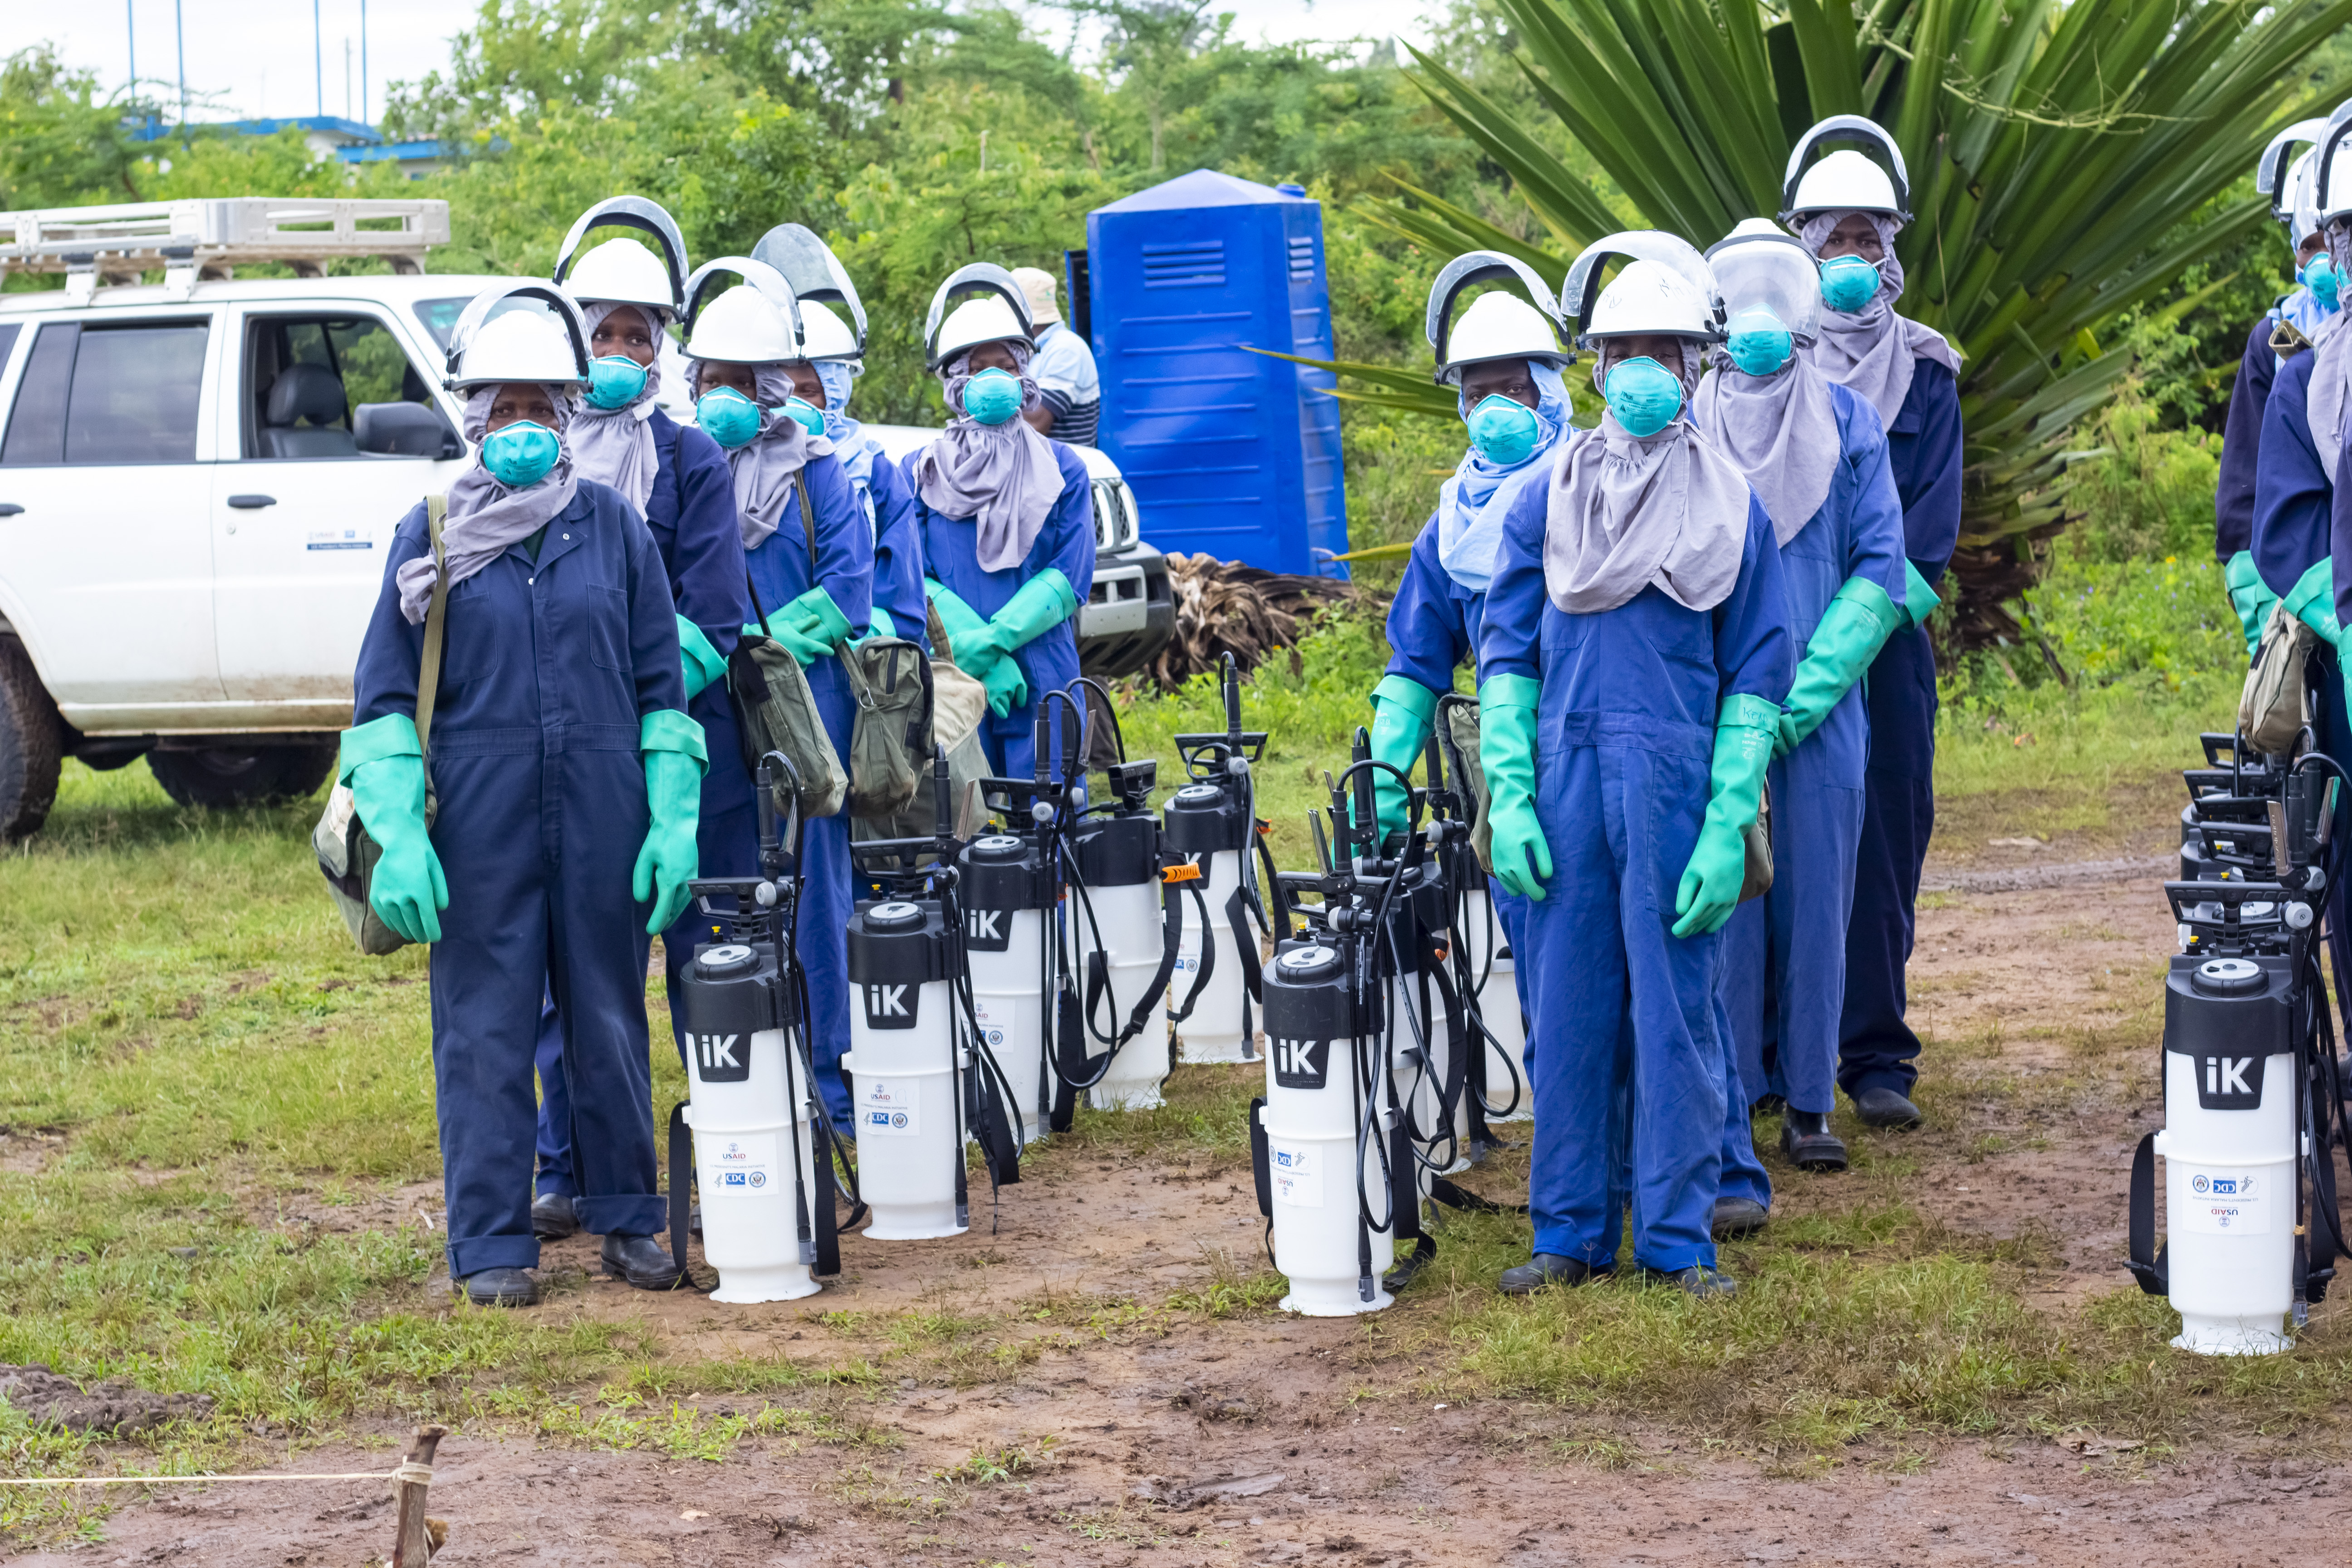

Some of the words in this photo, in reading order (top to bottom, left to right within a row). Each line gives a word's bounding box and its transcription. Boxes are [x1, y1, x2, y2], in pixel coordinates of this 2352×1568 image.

[970, 909, 1003, 940] iK
[871, 984, 911, 1016] iK
[701, 1034, 742, 1068] iK
[1279, 1038, 1319, 1075] iK
[2206, 1057, 2255, 1094] iK
[872, 1113, 888, 1122] CDC
[1278, 1155, 1291, 1166] CDC
[726, 1174, 745, 1182] CDC
[1278, 1178, 1293, 1187] USAID
[2214, 1183, 2235, 1193] CDC
